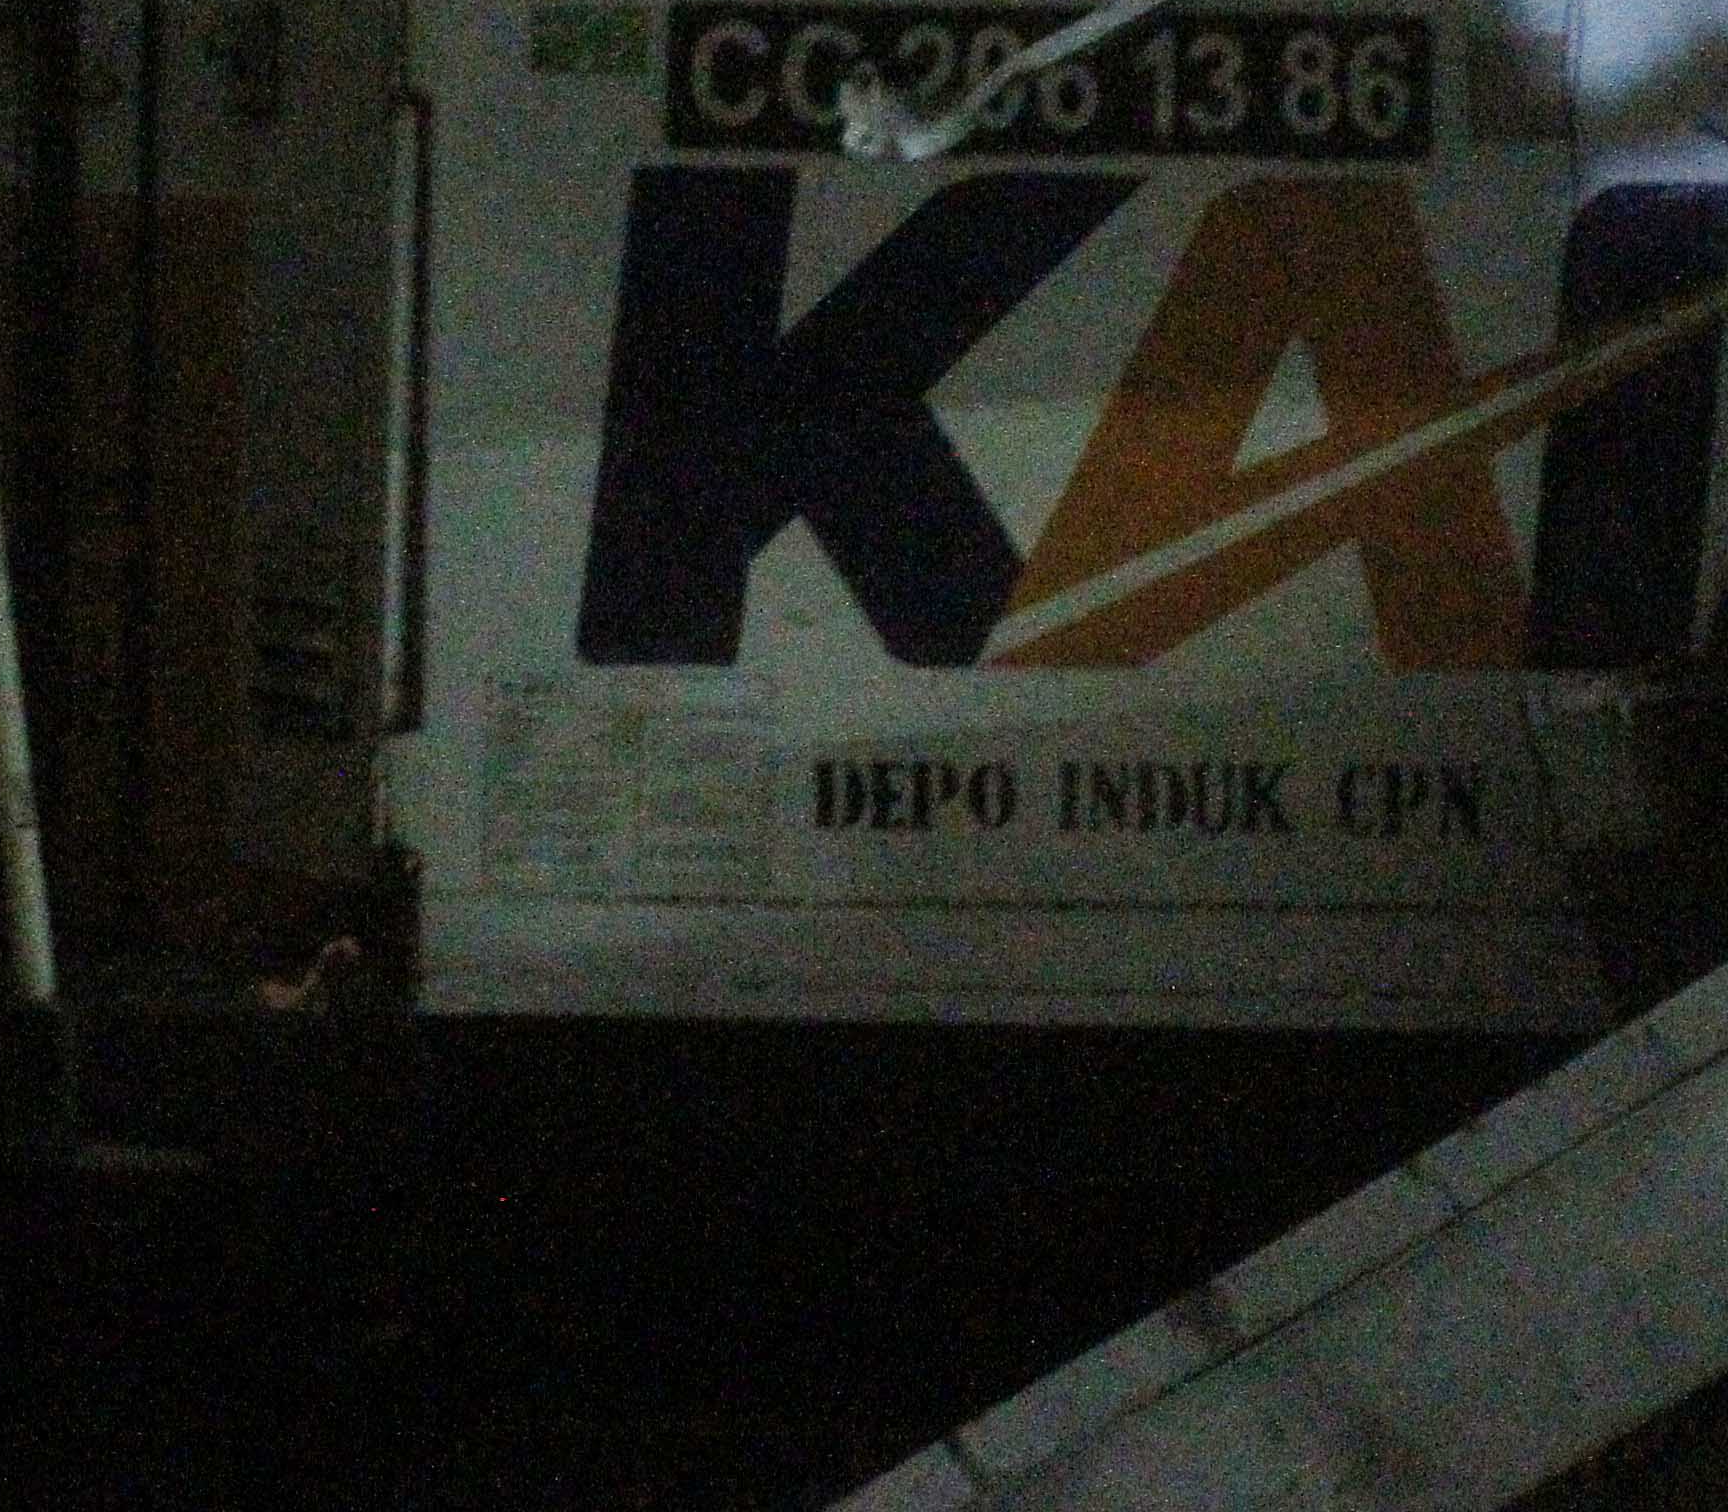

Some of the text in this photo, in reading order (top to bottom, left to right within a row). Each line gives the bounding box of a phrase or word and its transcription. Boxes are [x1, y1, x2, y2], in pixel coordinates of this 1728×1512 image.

[689, 20, 866, 128] CC
[1136, 28, 1249, 139] 13
[1282, 31, 1412, 142] 86
[813, 759, 1484, 839] DEPO INDUK CPN
